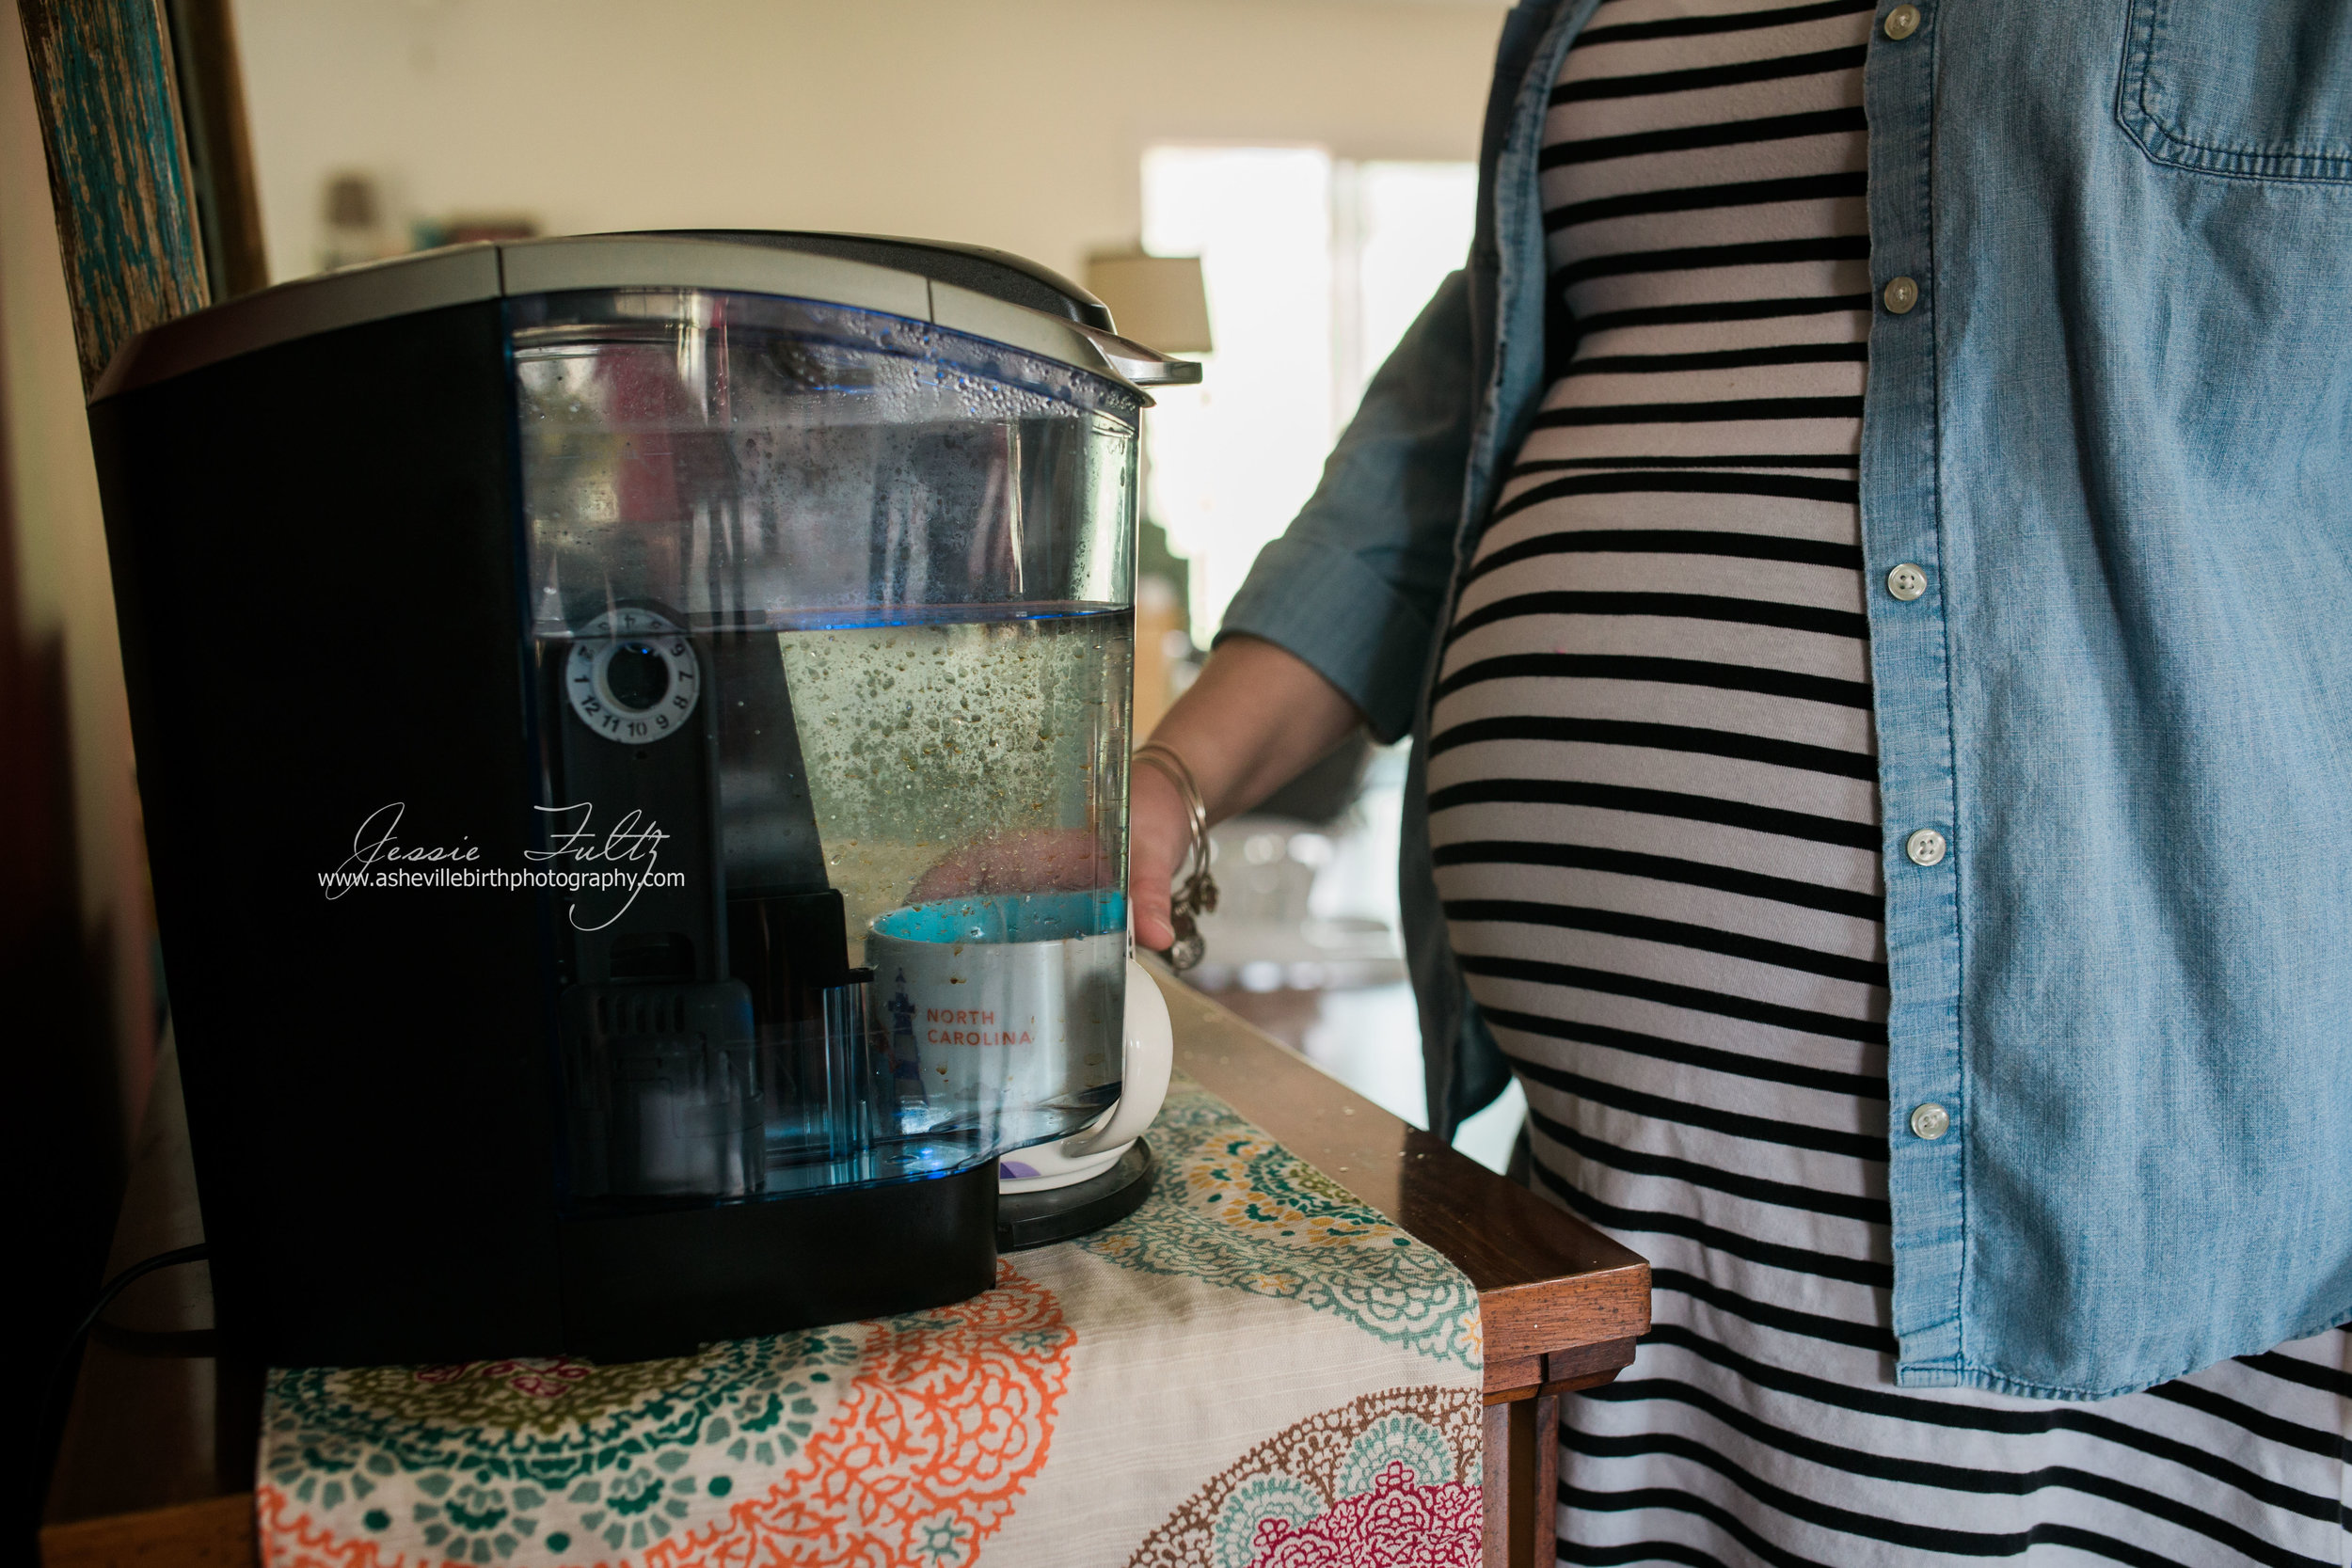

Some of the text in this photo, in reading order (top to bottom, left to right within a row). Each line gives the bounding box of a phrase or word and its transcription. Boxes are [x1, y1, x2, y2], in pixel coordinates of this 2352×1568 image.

[678, 671, 693, 682] 7
[580, 695, 601, 717] 12
[673, 695, 689, 709] 8
[602, 715, 620, 733] 11
[627, 721, 648, 737] 10
[655, 715, 670, 729] 9
[927, 1008, 994, 1025] NORTH
[927, 1029, 1033, 1046] CAROLINA
